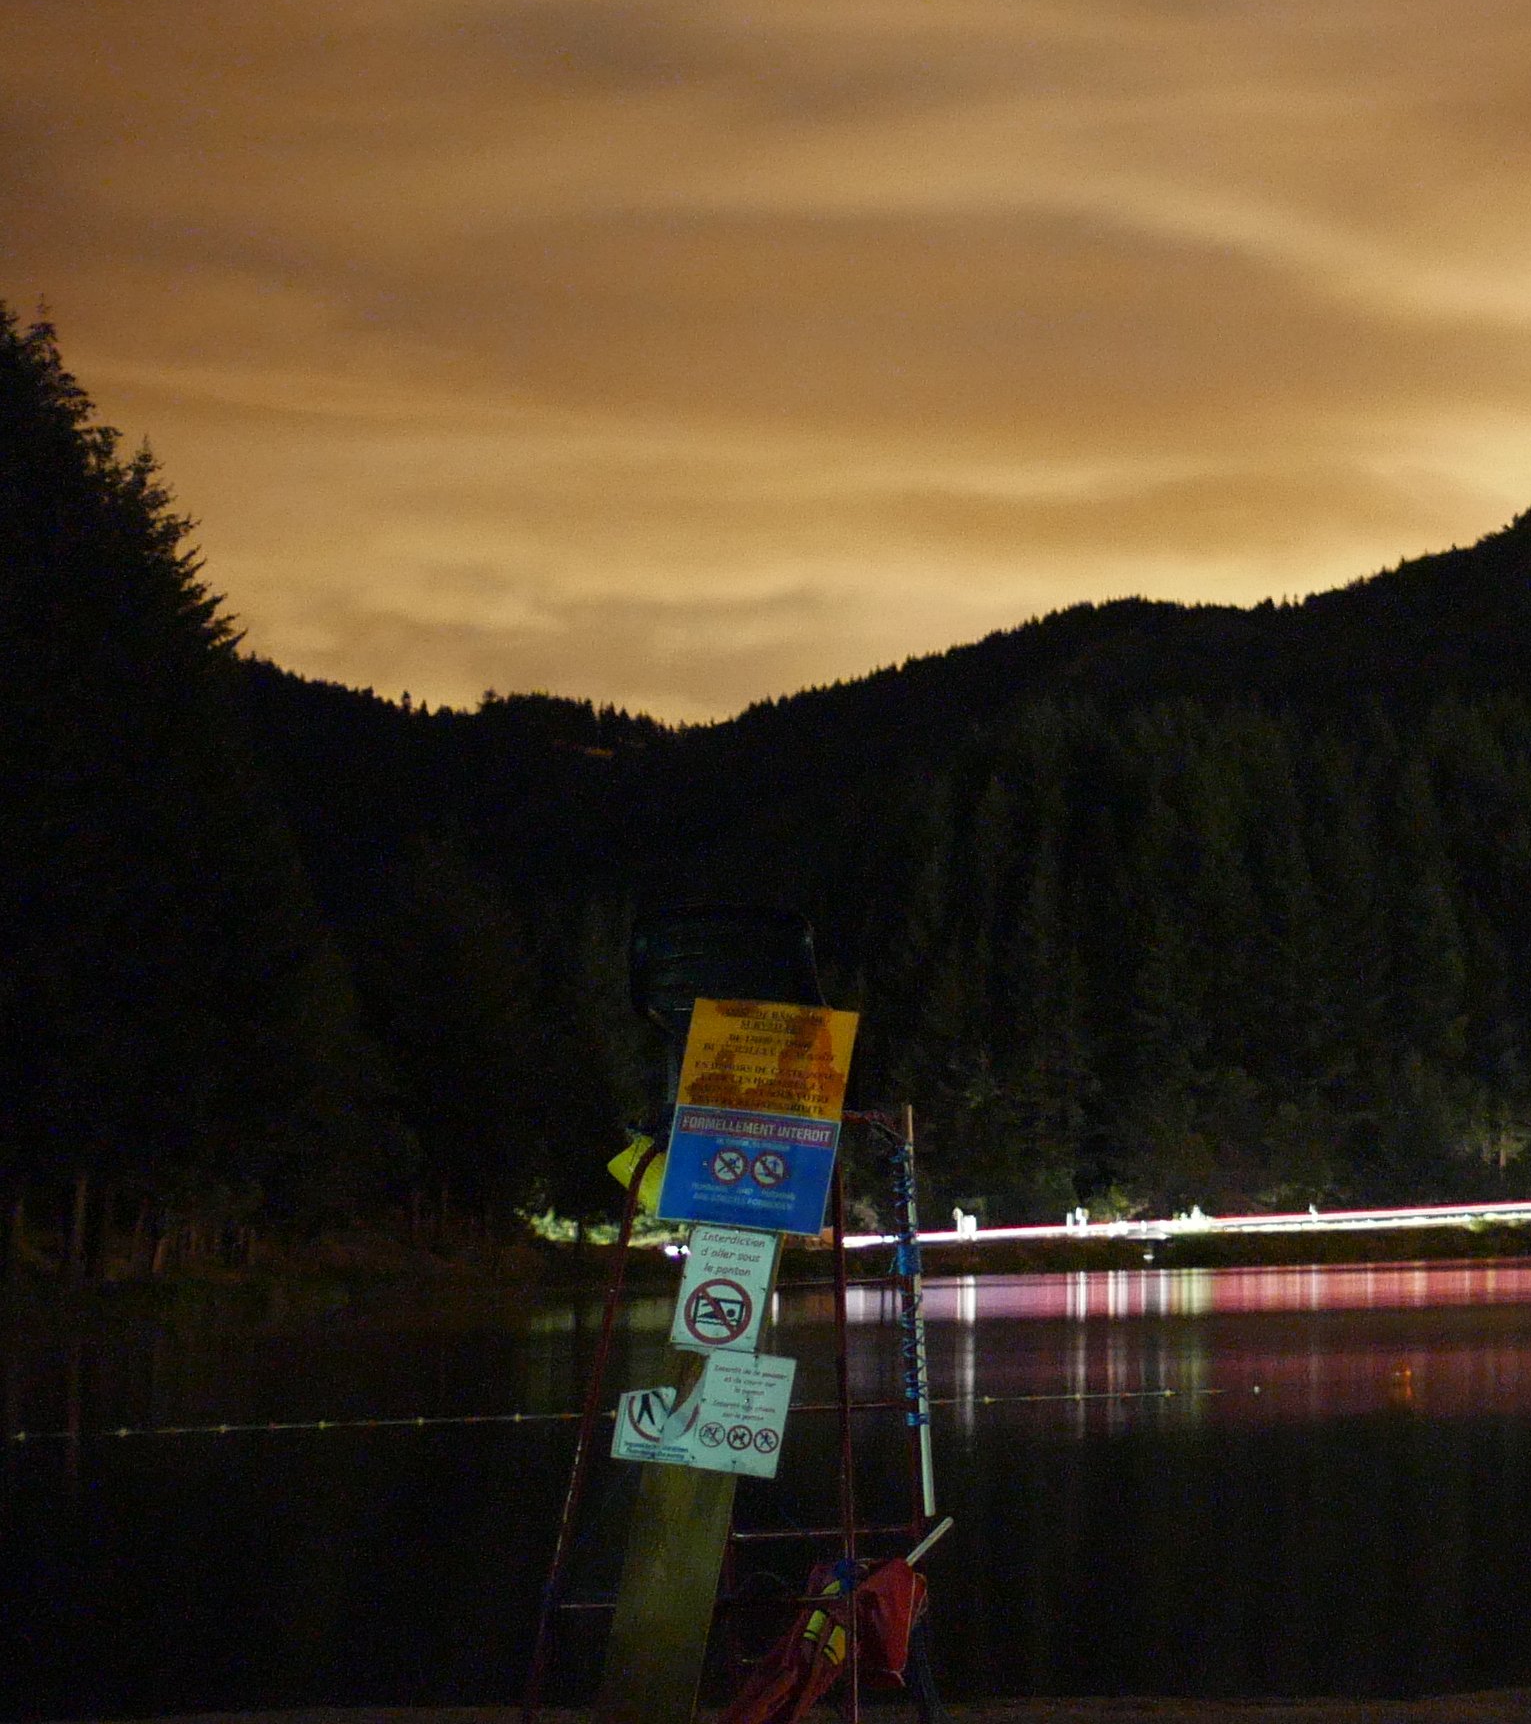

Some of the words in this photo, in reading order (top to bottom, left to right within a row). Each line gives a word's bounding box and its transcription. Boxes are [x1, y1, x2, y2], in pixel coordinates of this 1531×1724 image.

[682, 1114, 775, 1136] FORMELLEMENT
[777, 1125, 832, 1142] INTERDIT
[701, 1232, 766, 1248] Interdiction
[737, 1254, 761, 1263] sous
[704, 1262, 714, 1272] le
[715, 1266, 751, 1276] ponton
